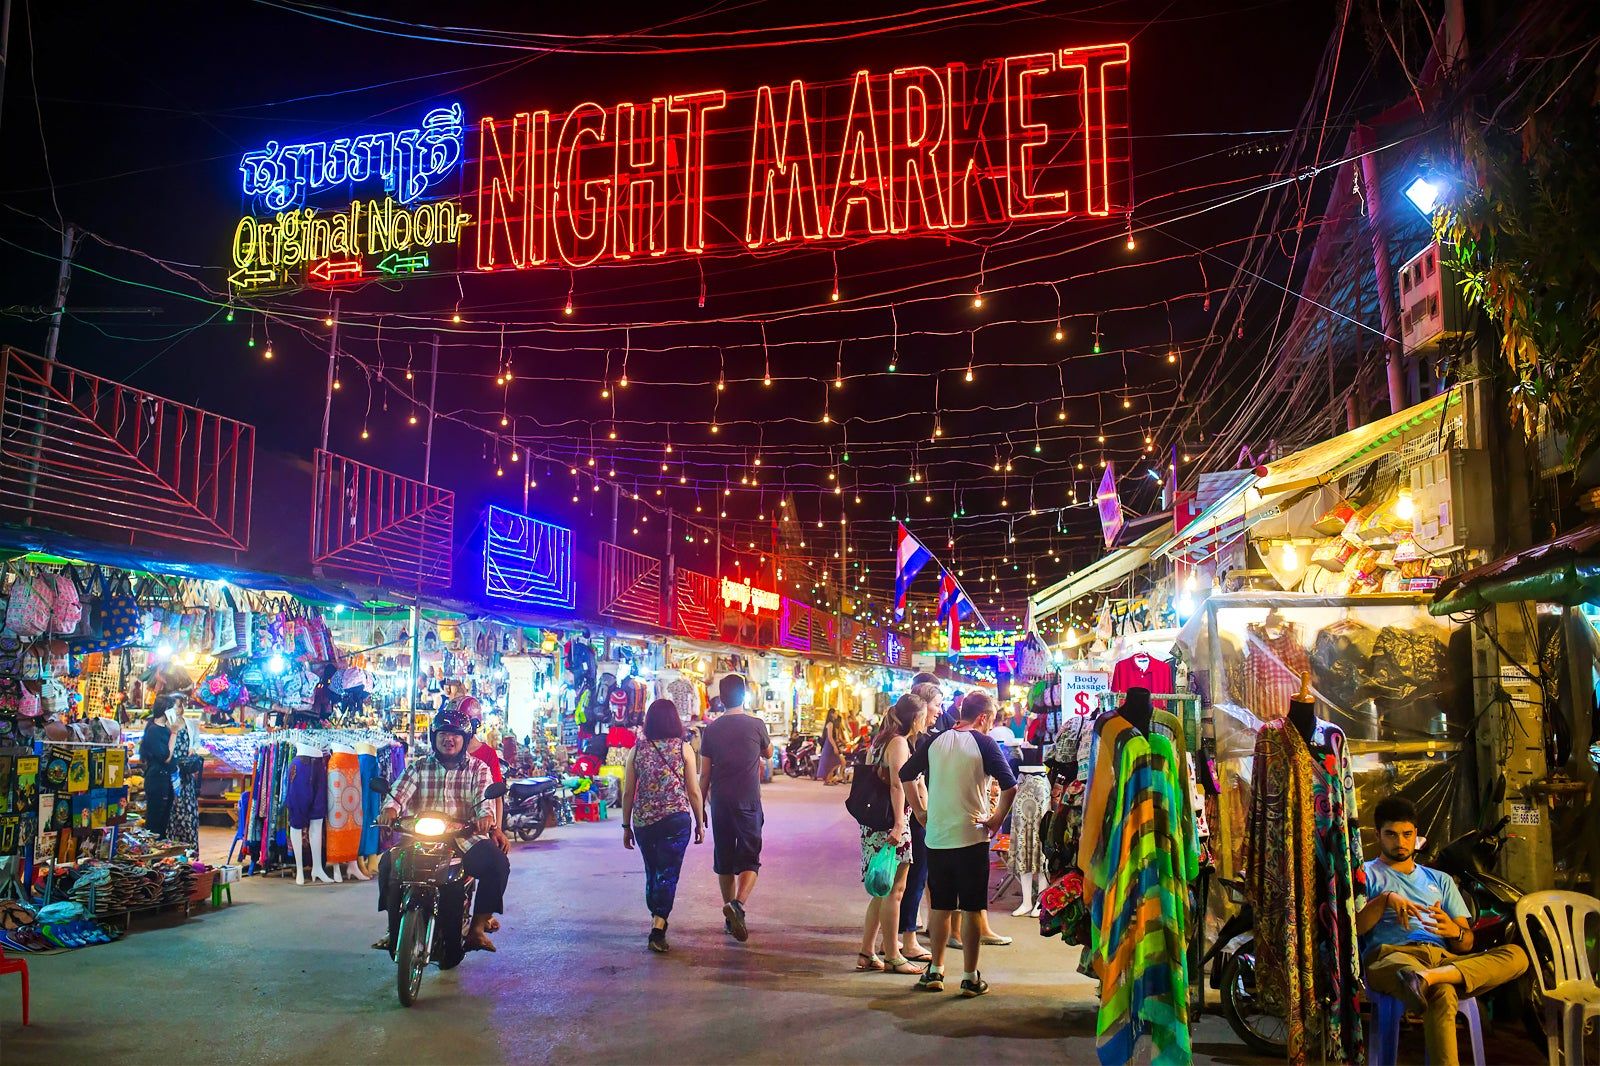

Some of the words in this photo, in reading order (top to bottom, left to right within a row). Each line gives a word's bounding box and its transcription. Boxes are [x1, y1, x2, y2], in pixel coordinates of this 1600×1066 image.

[477, 89, 727, 272] NIGHT
[746, 42, 1131, 249] MARKET
[232, 200, 362, 268] Original
[1067, 683, 1106, 691] Massage
[1074, 675, 1099, 684] Body
